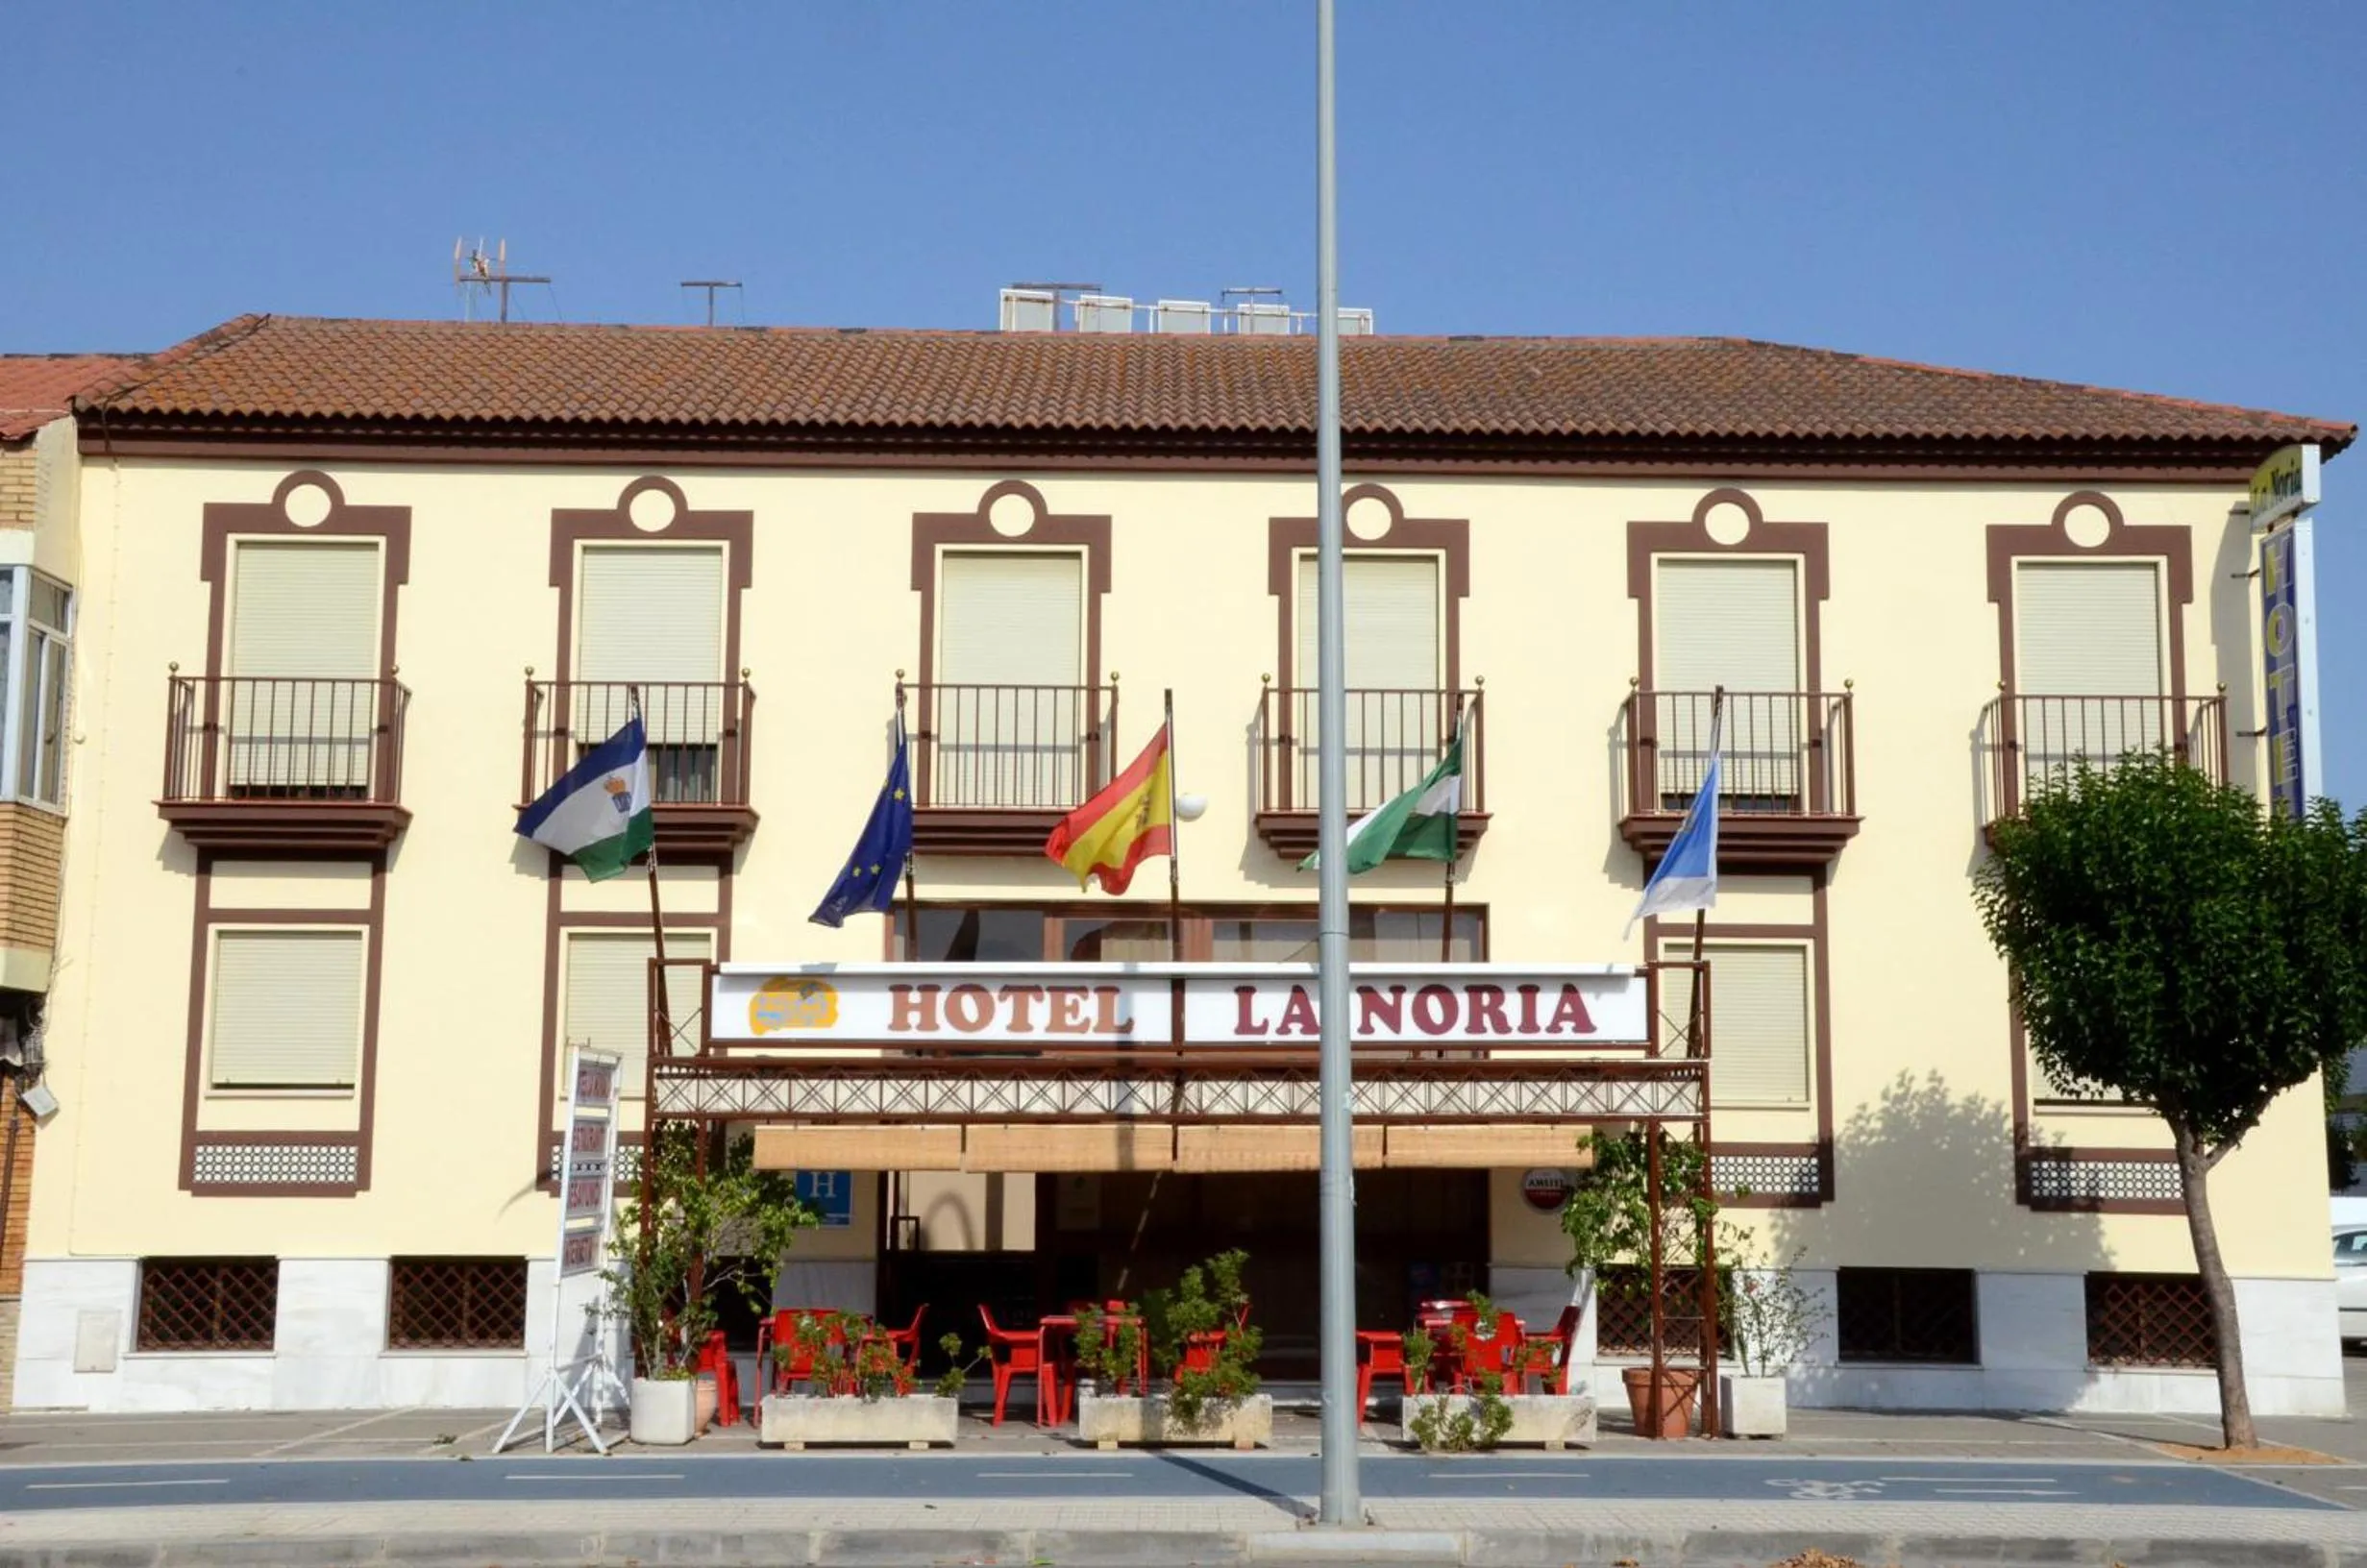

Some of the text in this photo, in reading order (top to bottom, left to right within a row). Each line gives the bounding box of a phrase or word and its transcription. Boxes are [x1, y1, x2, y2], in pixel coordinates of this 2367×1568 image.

[2265, 532, 2300, 817] HOTE
[888, 983, 1597, 1035] HOTEL LA NORIA
[809, 1171, 837, 1198] H
